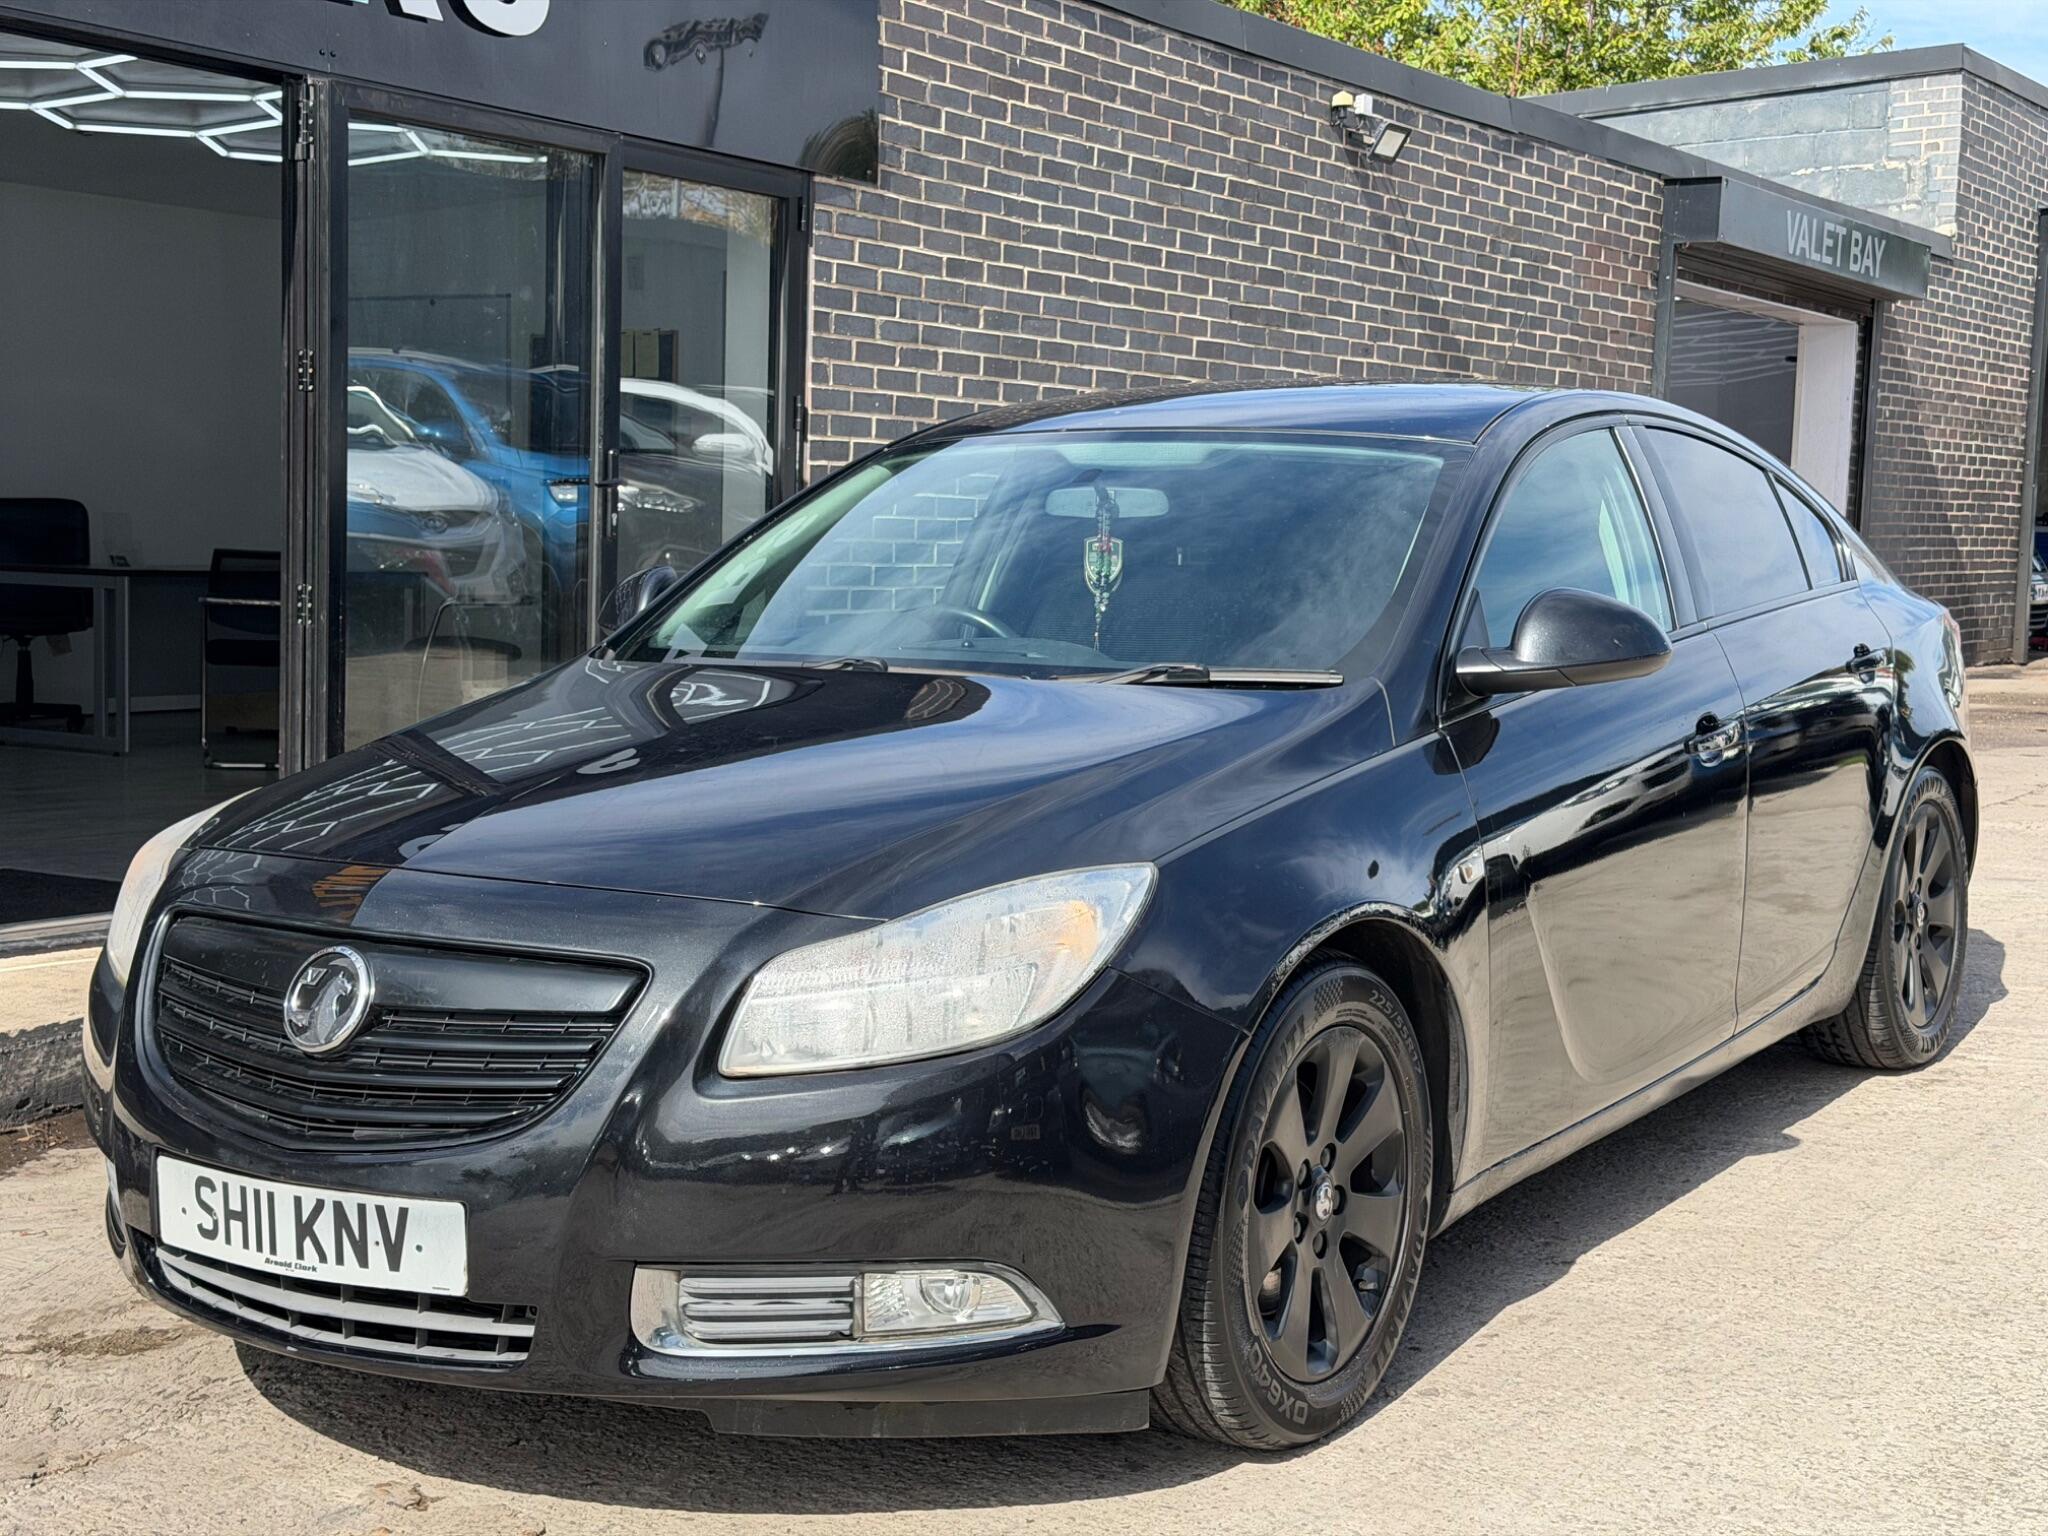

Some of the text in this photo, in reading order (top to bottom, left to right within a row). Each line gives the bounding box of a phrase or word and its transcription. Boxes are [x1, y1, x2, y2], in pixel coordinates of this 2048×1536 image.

[1786, 210, 1886, 278] VALET BAY
[264, 1257, 318, 1273] Arnold Clark
[294, 1195, 409, 1272] KNV
[1248, 1342, 1309, 1425] DX640
